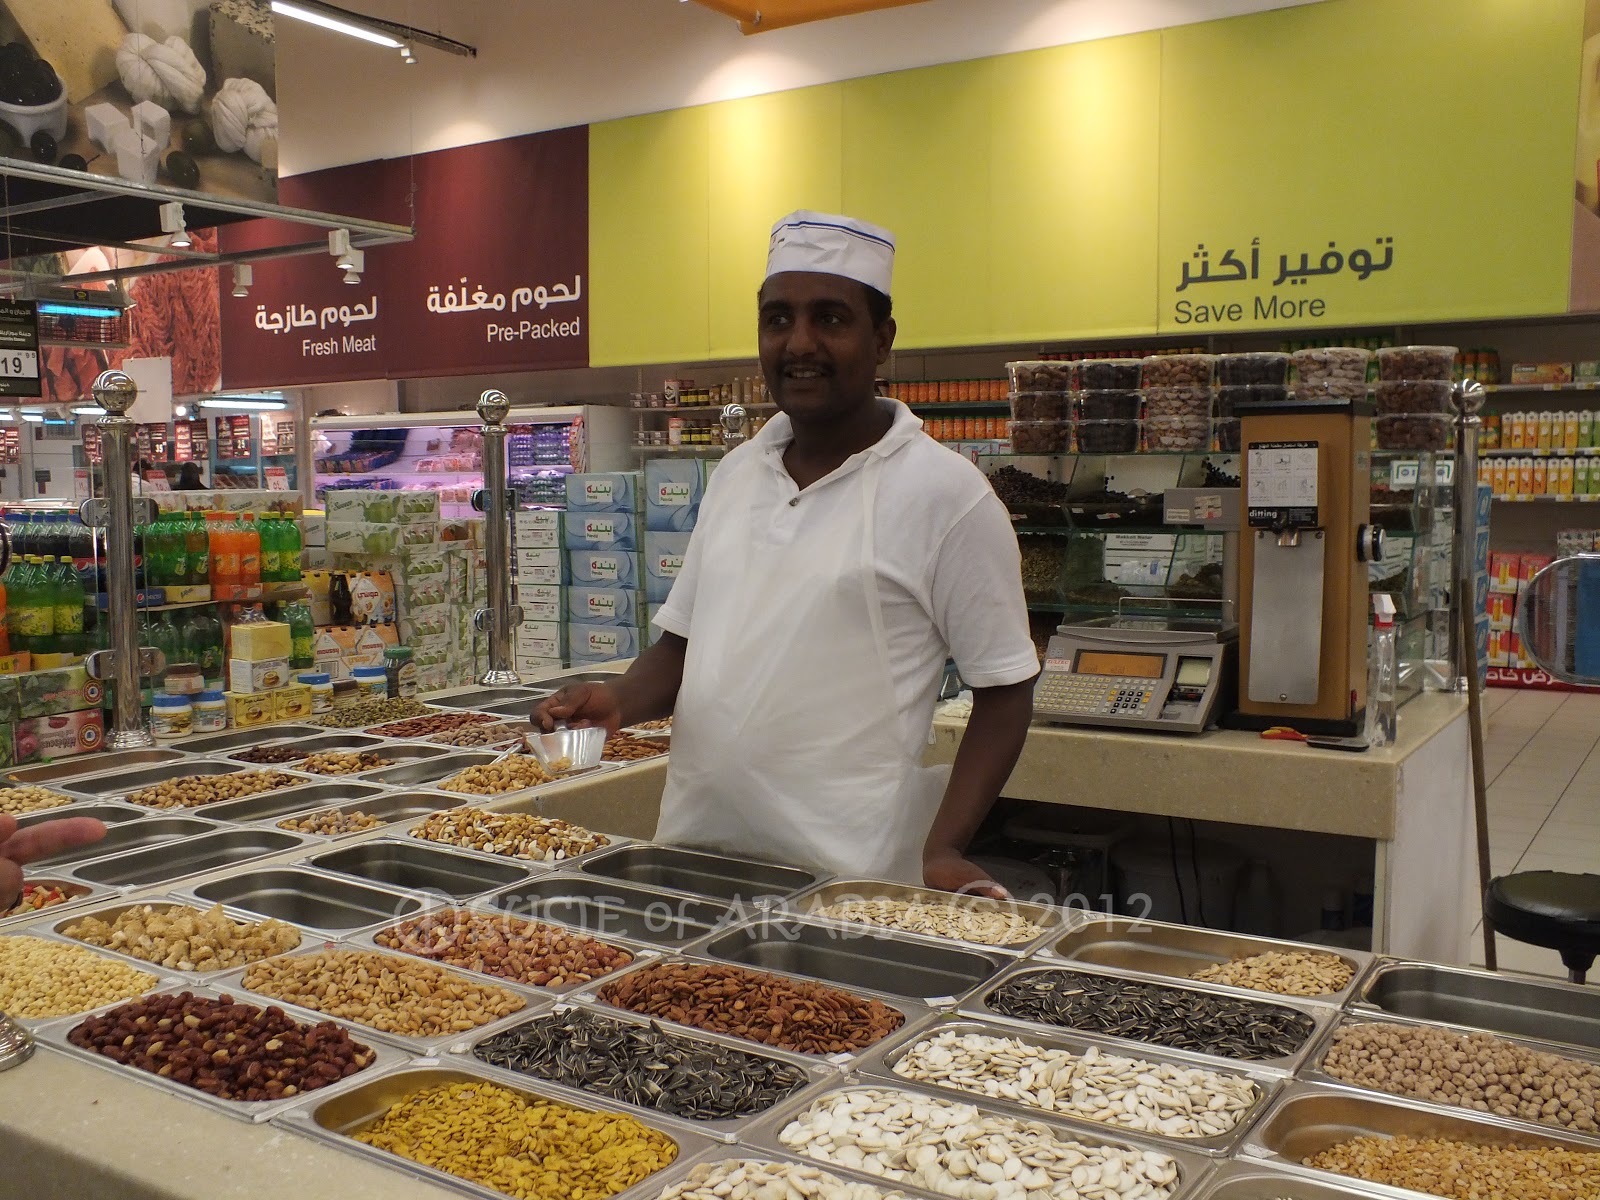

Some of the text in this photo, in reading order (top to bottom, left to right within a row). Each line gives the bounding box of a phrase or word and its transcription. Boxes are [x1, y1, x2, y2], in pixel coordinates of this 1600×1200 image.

[1176, 237, 1393, 292] توفير أكثر
[512, 275, 581, 311] لحوم
[255, 296, 377, 334] لحوم طازجة
[1174, 295, 1326, 324] Save More
[487, 316, 580, 342] Pre-Packed
[302, 335, 376, 357] Fresh Meat
[1249, 510, 1277, 518] ditting
